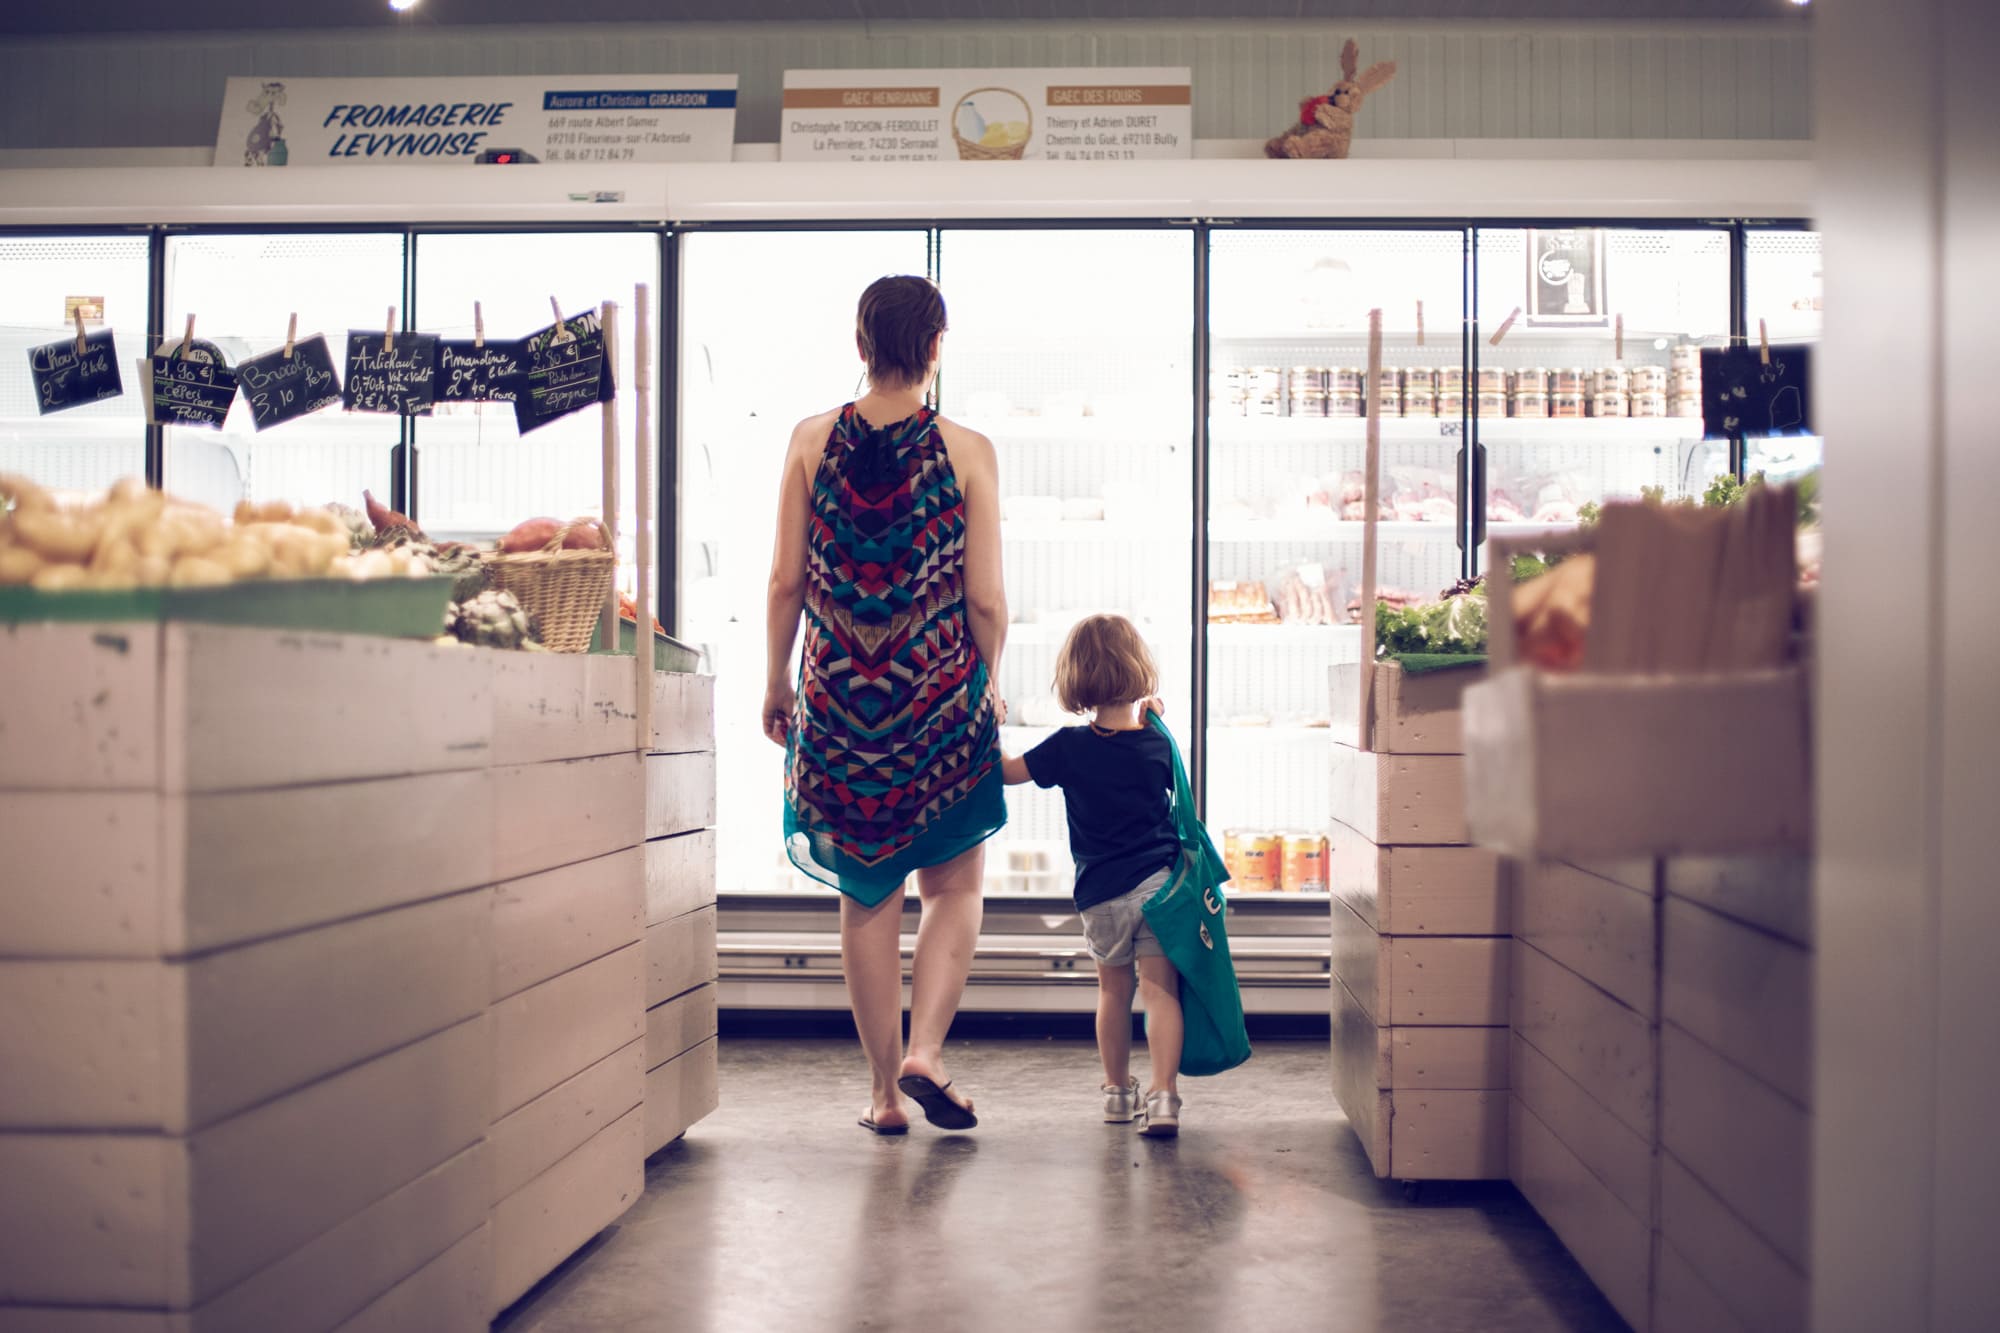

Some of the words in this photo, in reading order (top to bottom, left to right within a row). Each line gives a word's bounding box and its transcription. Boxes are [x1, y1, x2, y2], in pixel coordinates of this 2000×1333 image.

[586, 95, 598, 107] et
[600, 94, 647, 107] Christian
[648, 92, 708, 106] GIRARDON
[1053, 89, 1080, 103] GAEC
[1083, 89, 1104, 103] DES
[1106, 88, 1143, 103] FOURS
[322, 102, 513, 129] FROMAGERIE
[568, 117, 593, 128] route
[595, 115, 624, 128] Albert
[1047, 116, 1078, 129] Thierry
[1080, 116, 1090, 128] et
[1092, 116, 1124, 128] Adrien
[790, 121, 841, 135] Christophe
[328, 131, 488, 157] LEVYNOISE
[1046, 134, 1082, 146] Chemin
[1084, 134, 1096, 146] du
[350, 345, 423, 371] Artichaut
[442, 346, 510, 368] Amandine
